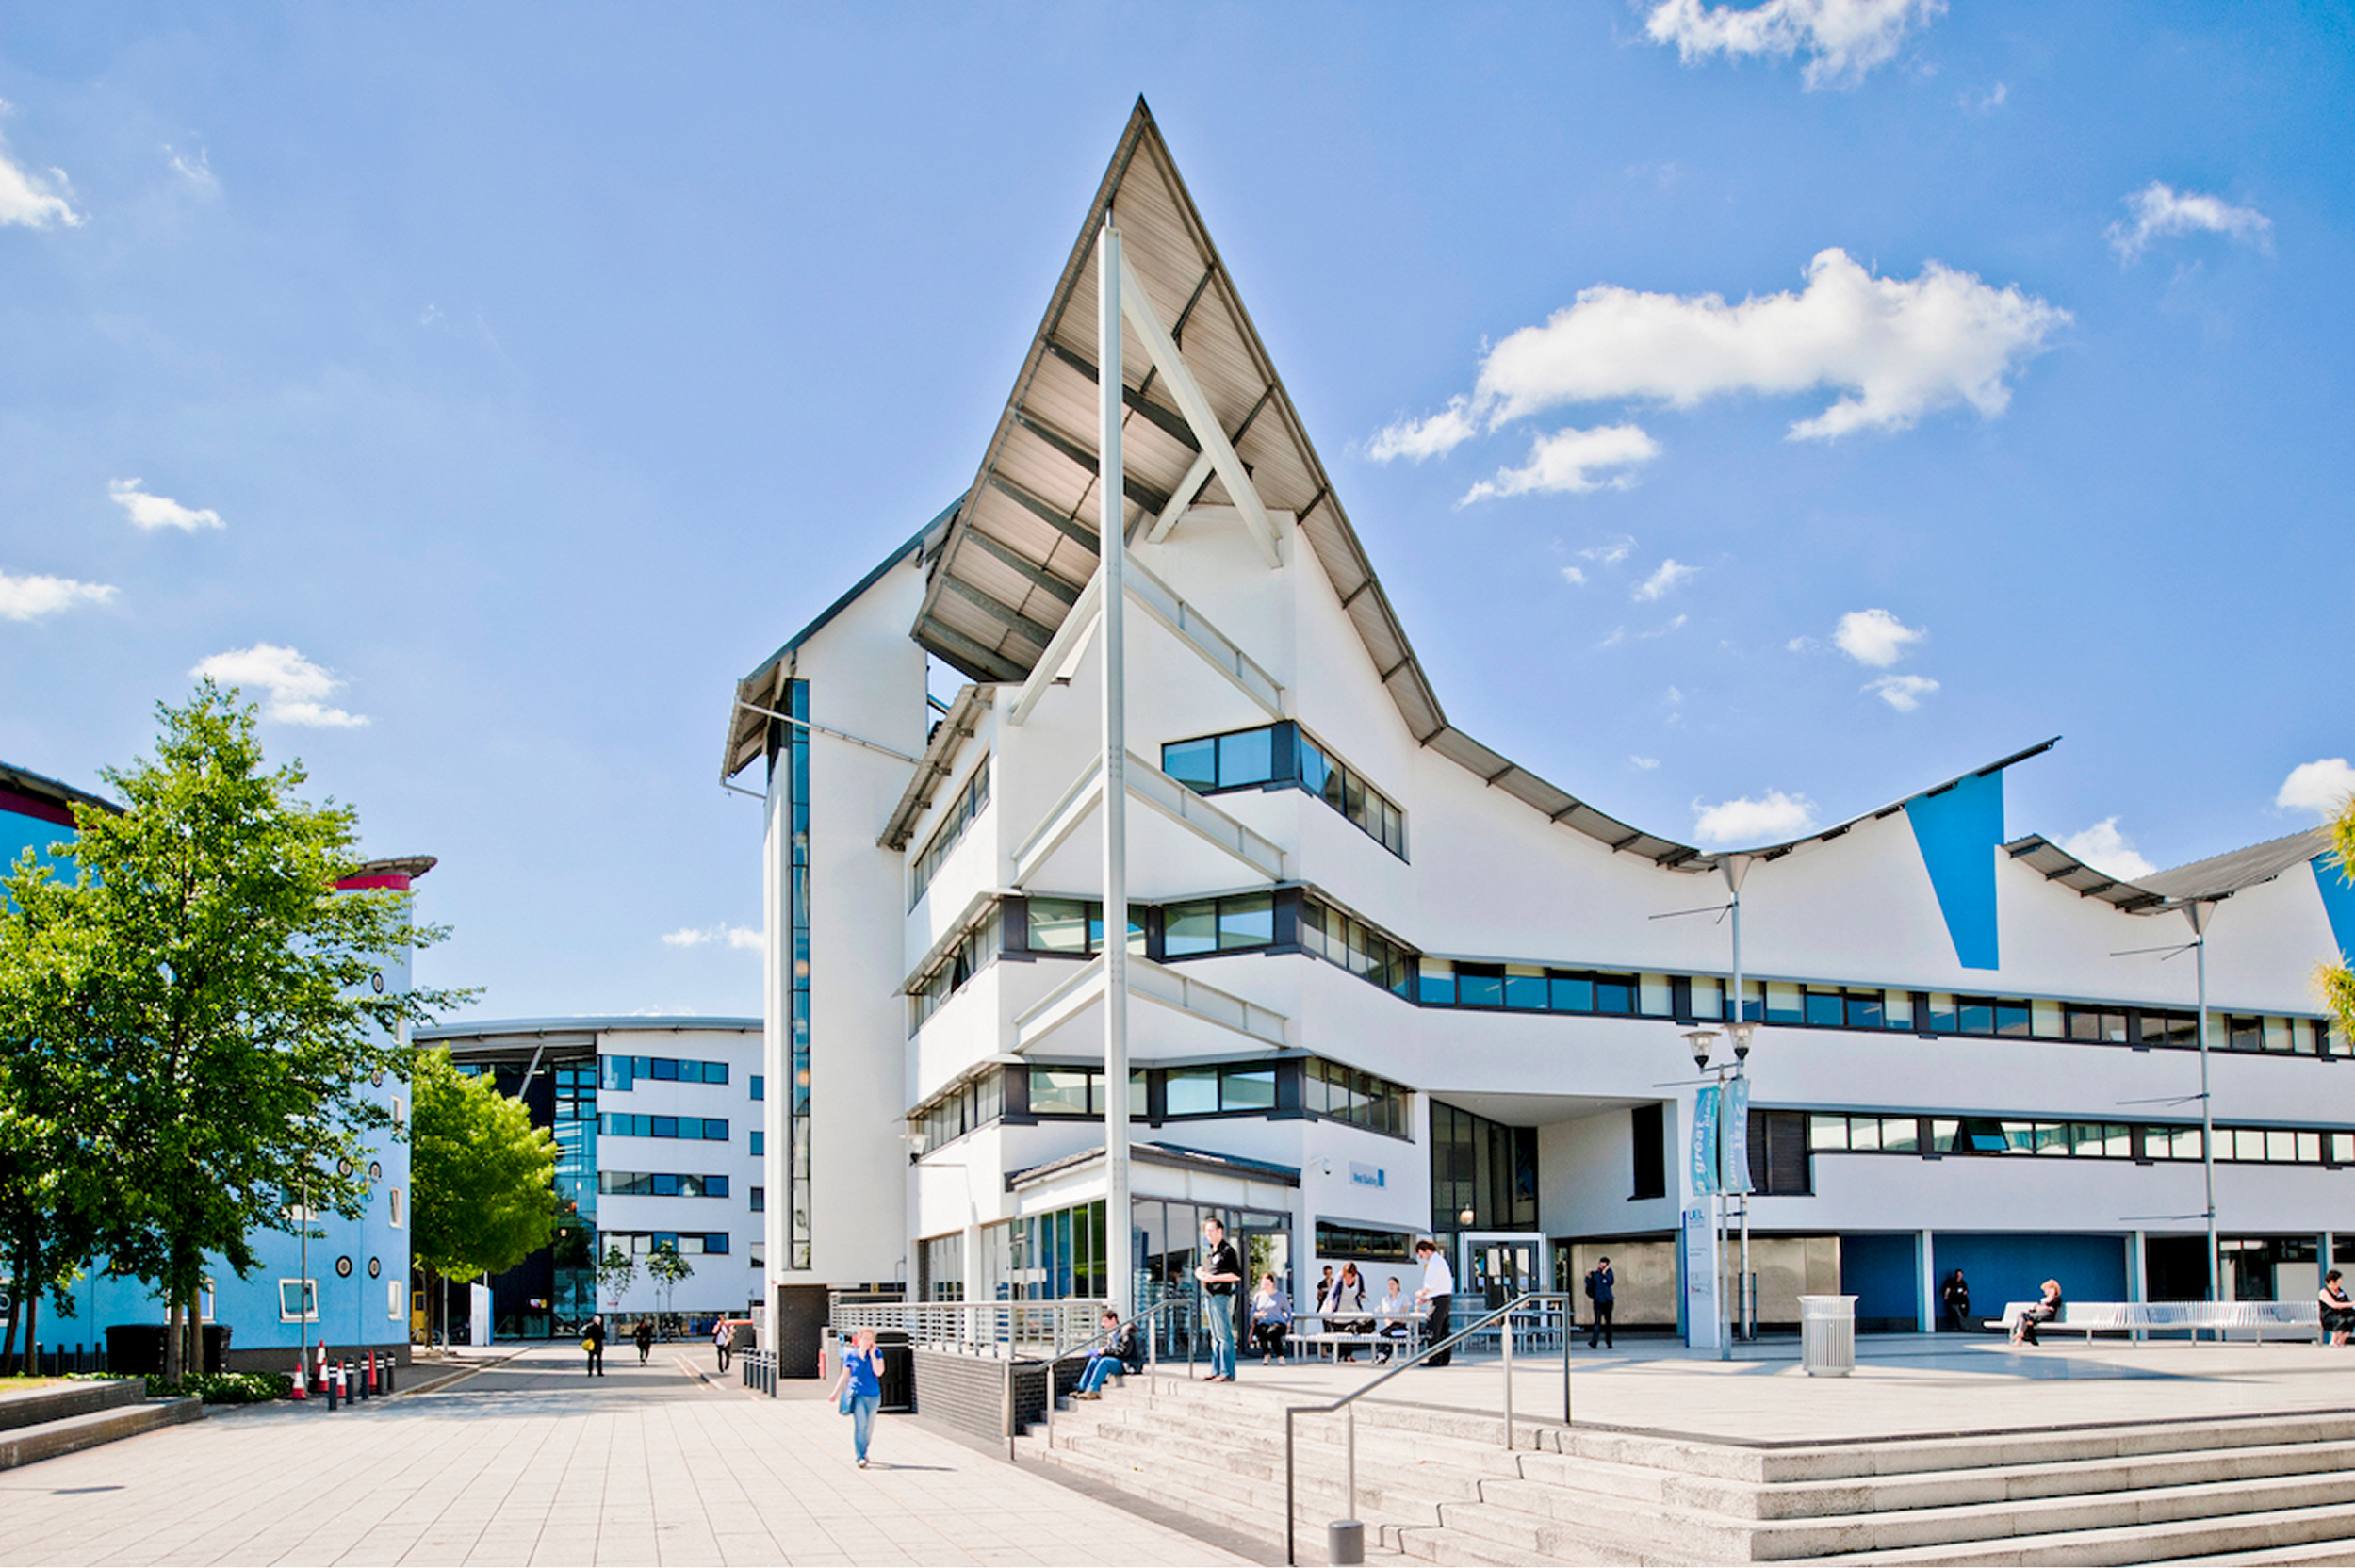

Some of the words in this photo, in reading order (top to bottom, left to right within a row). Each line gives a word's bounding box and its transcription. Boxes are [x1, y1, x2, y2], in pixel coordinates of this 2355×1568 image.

[1703, 1091, 1712, 1128] place
[1735, 1102, 1743, 1149] 21st
[1694, 1120, 1707, 1174] great
[1729, 1134, 1739, 1187] century
[1695, 1181, 1706, 1192] a
